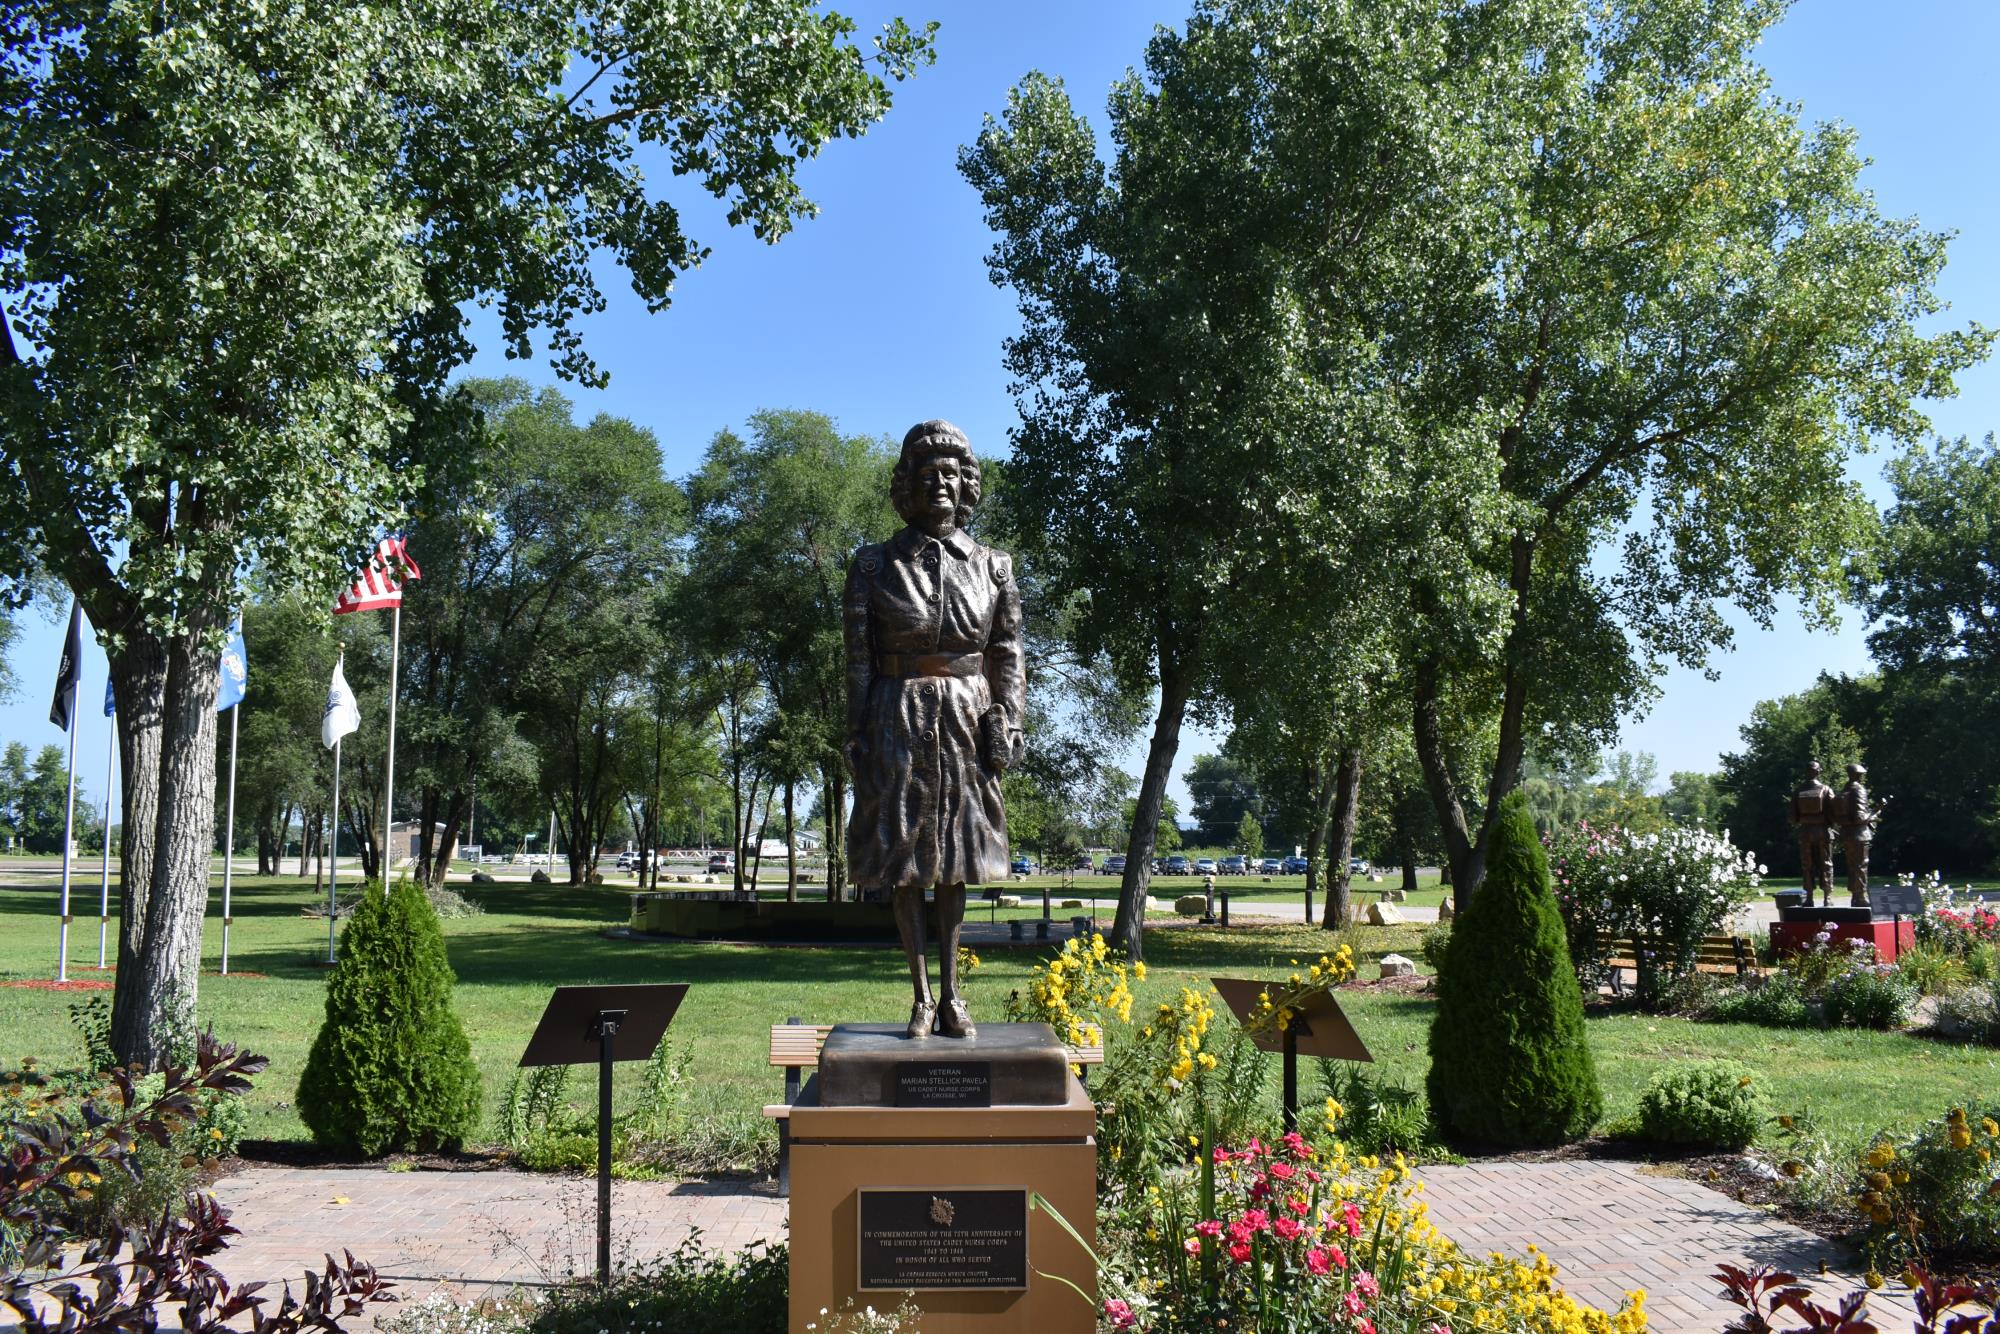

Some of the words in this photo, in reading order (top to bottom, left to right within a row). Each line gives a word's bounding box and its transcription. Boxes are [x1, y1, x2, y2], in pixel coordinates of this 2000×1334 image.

[928, 1068, 961, 1076] VETERAN
[901, 1077, 928, 1085] MARIAN
[929, 1077, 961, 1085] STELLICK
[962, 1077, 988, 1085] PAVELA
[928, 1256, 937, 1264] OF
